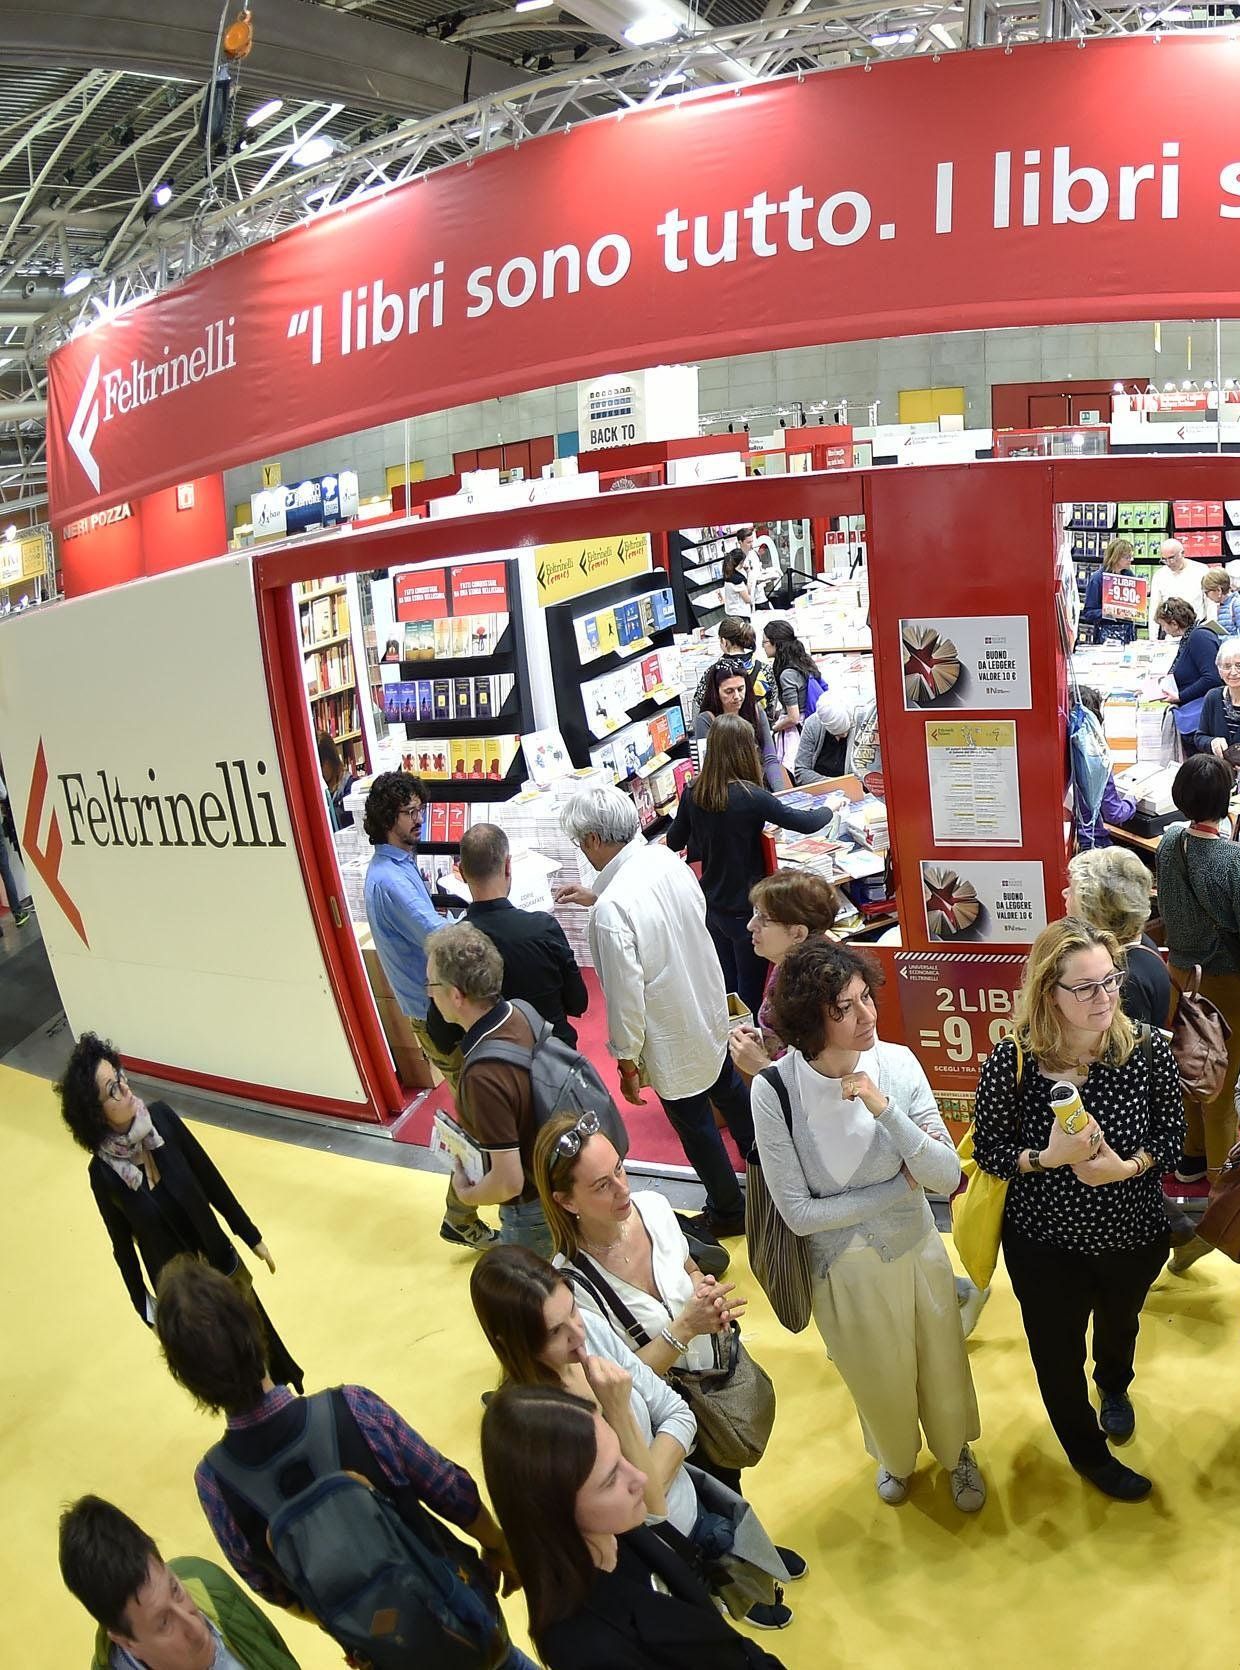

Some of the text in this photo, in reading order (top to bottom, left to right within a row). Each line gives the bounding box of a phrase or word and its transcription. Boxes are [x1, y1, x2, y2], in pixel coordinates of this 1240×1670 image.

[341, 261, 444, 356] libri
[466, 233, 631, 318] sono
[656, 185, 896, 273] tutto.
[935, 161, 953, 234] I
[993, 141, 1180, 229] libri
[102, 316, 237, 422] Feltrinelli
[590, 423, 635, 445] BACK TO
[90, 502, 132, 529] POZZA
[985, 650, 1007, 660] BUONO
[978, 660, 1016, 670] DA LEGGERE
[978, 672, 1001, 681] VALORE
[1002, 671, 1011, 680] 10
[57, 759, 287, 850] Feltrinelli
[1003, 892, 1024, 901] BUONO
[996, 901, 1032, 910] DA LEGGERE
[996, 911, 1018, 920] VALORE
[1019, 911, 1028, 920] 10
[935, 987, 1020, 1013] 2 LIB
[933, 1065, 960, 1073] SCEGLI
